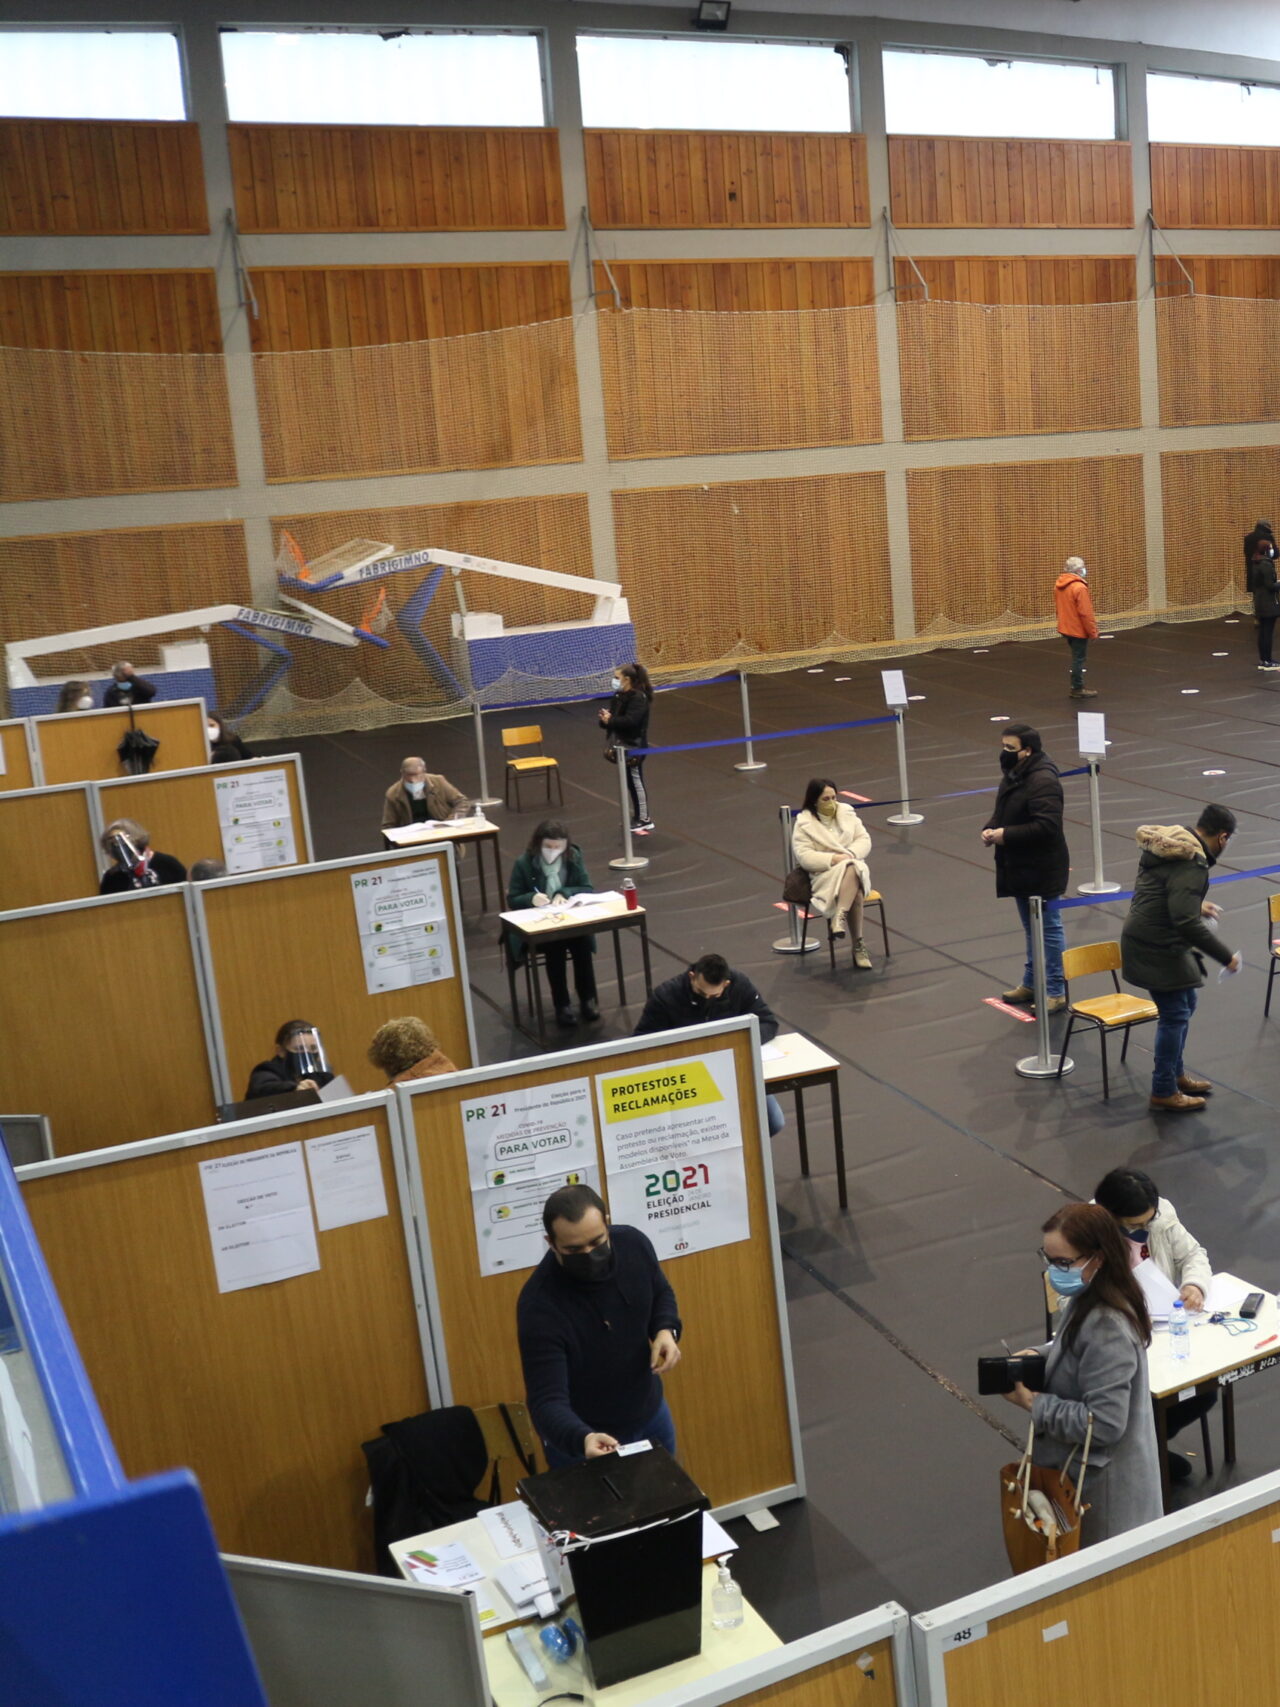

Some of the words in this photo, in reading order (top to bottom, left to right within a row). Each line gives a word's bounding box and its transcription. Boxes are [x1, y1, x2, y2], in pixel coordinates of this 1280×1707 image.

[371, 876, 383, 886] 21
[611, 1075, 678, 1098] PROTESTOS
[680, 1074, 687, 1084] E
[490, 1102, 508, 1118] 21
[613, 1087, 698, 1114] RECLAMAÇÕES
[615, 1131, 633, 1142] Caso
[633, 1125, 666, 1139] pretenda
[666, 1118, 704, 1134] apresentar
[701, 1133, 720, 1144] Mesa
[499, 1142, 529, 1156] PARA
[531, 1134, 567, 1149] VOTAR
[644, 1163, 710, 1198] 2021
[646, 1193, 685, 1210] ELEIÇÃO
[647, 1200, 712, 1221] PRESIDENCIAL
[953, 1627, 972, 1642] 48
